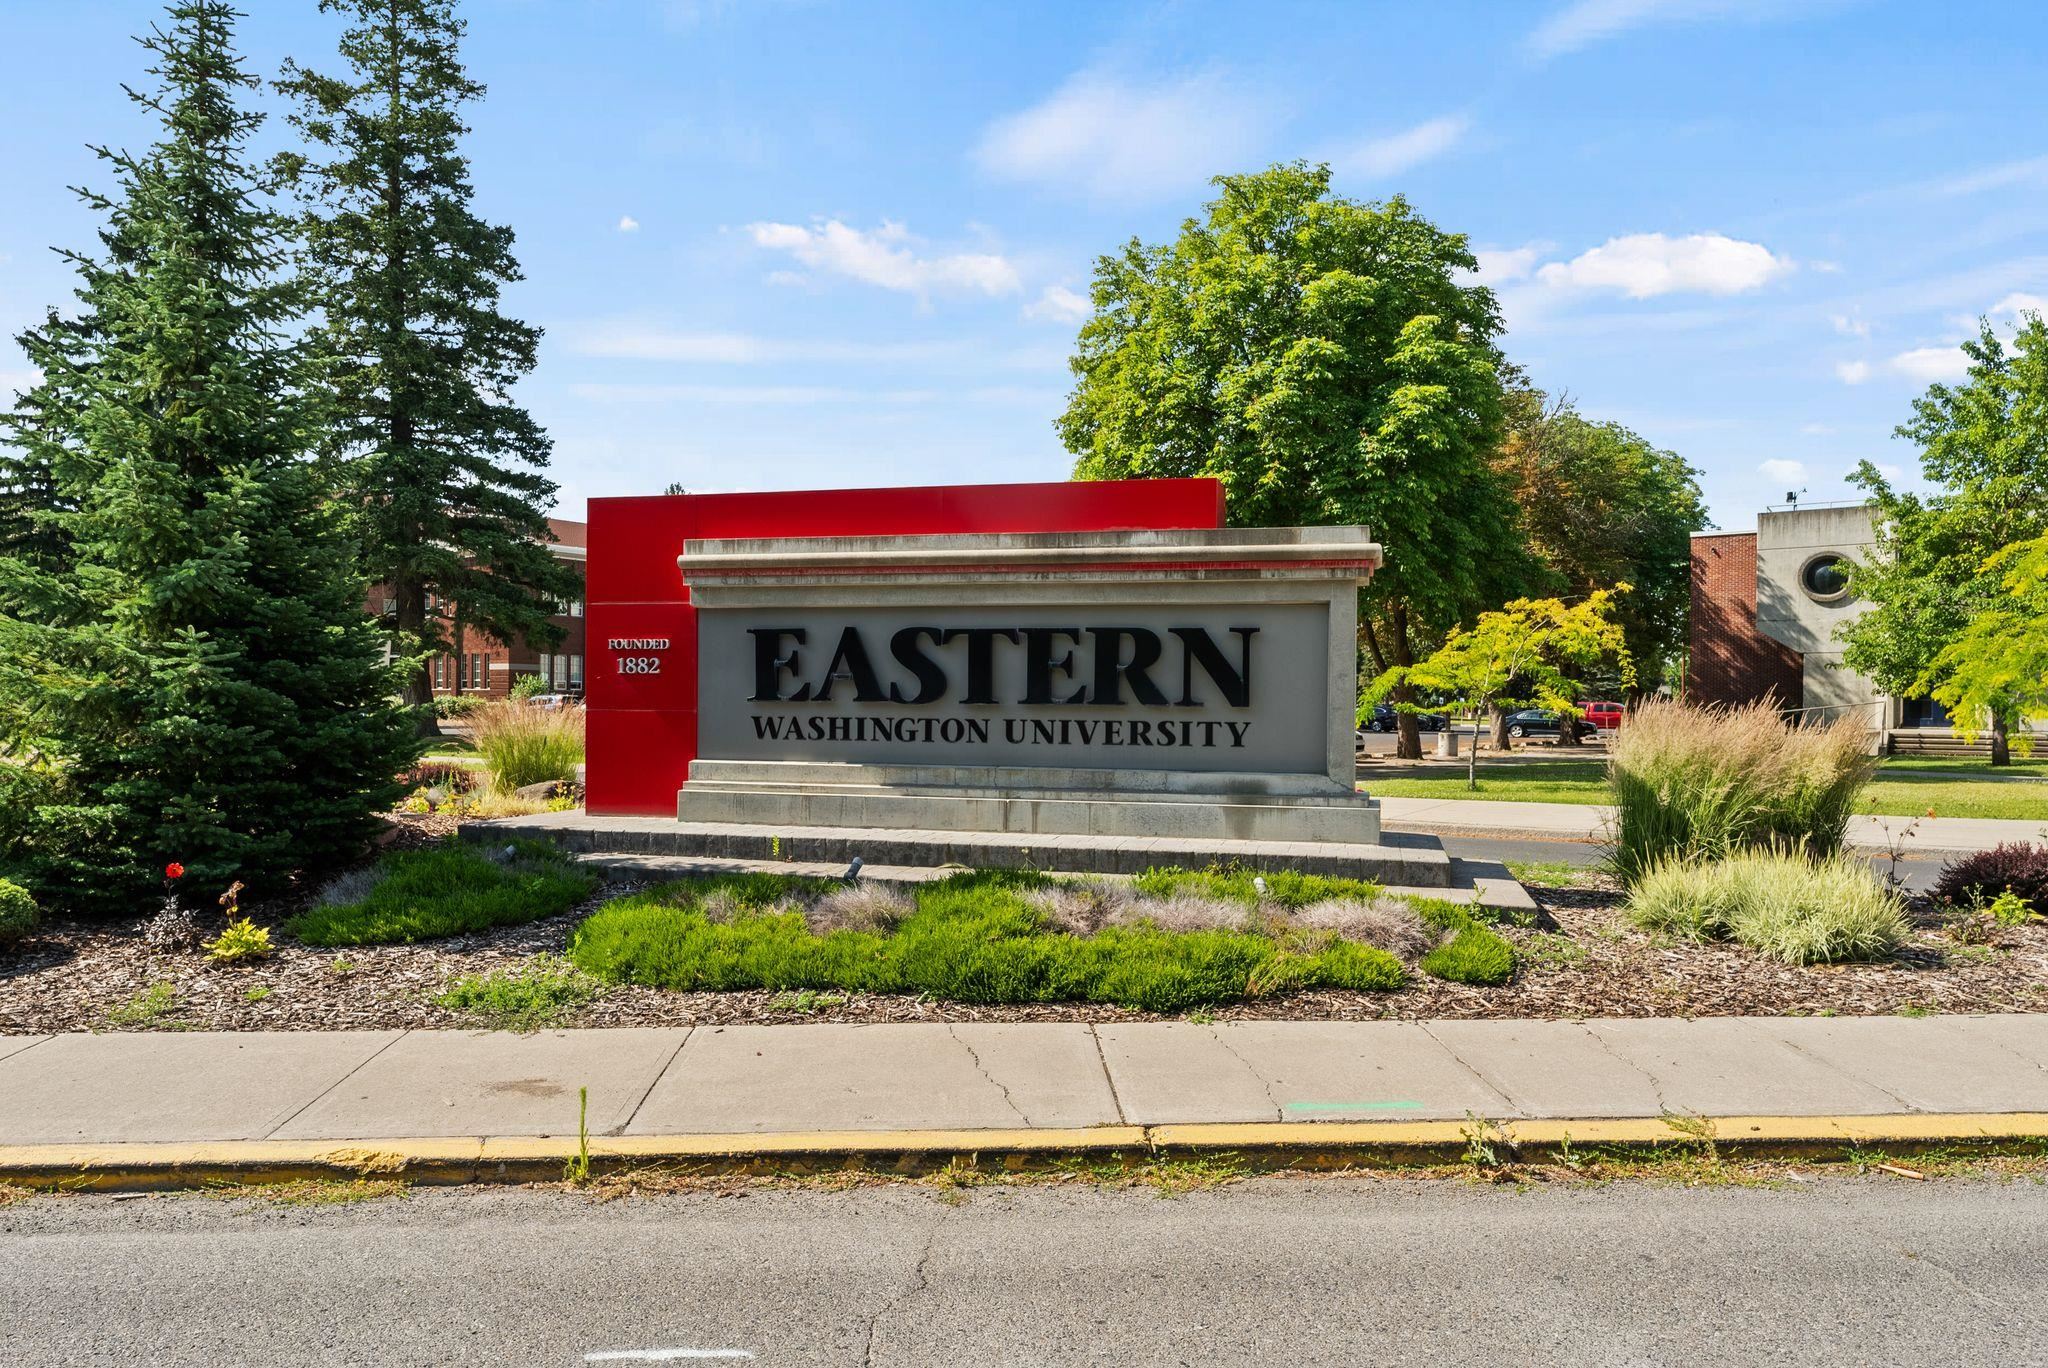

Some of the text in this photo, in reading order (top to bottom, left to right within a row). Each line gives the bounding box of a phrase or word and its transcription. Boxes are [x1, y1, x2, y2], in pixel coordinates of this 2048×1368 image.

[607, 638, 670, 650] FOUNDED
[616, 657, 661, 675] 1882
[746, 626, 1261, 707] EASTERN
[751, 715, 1252, 748] WASHINGTON UNIVERSITY
